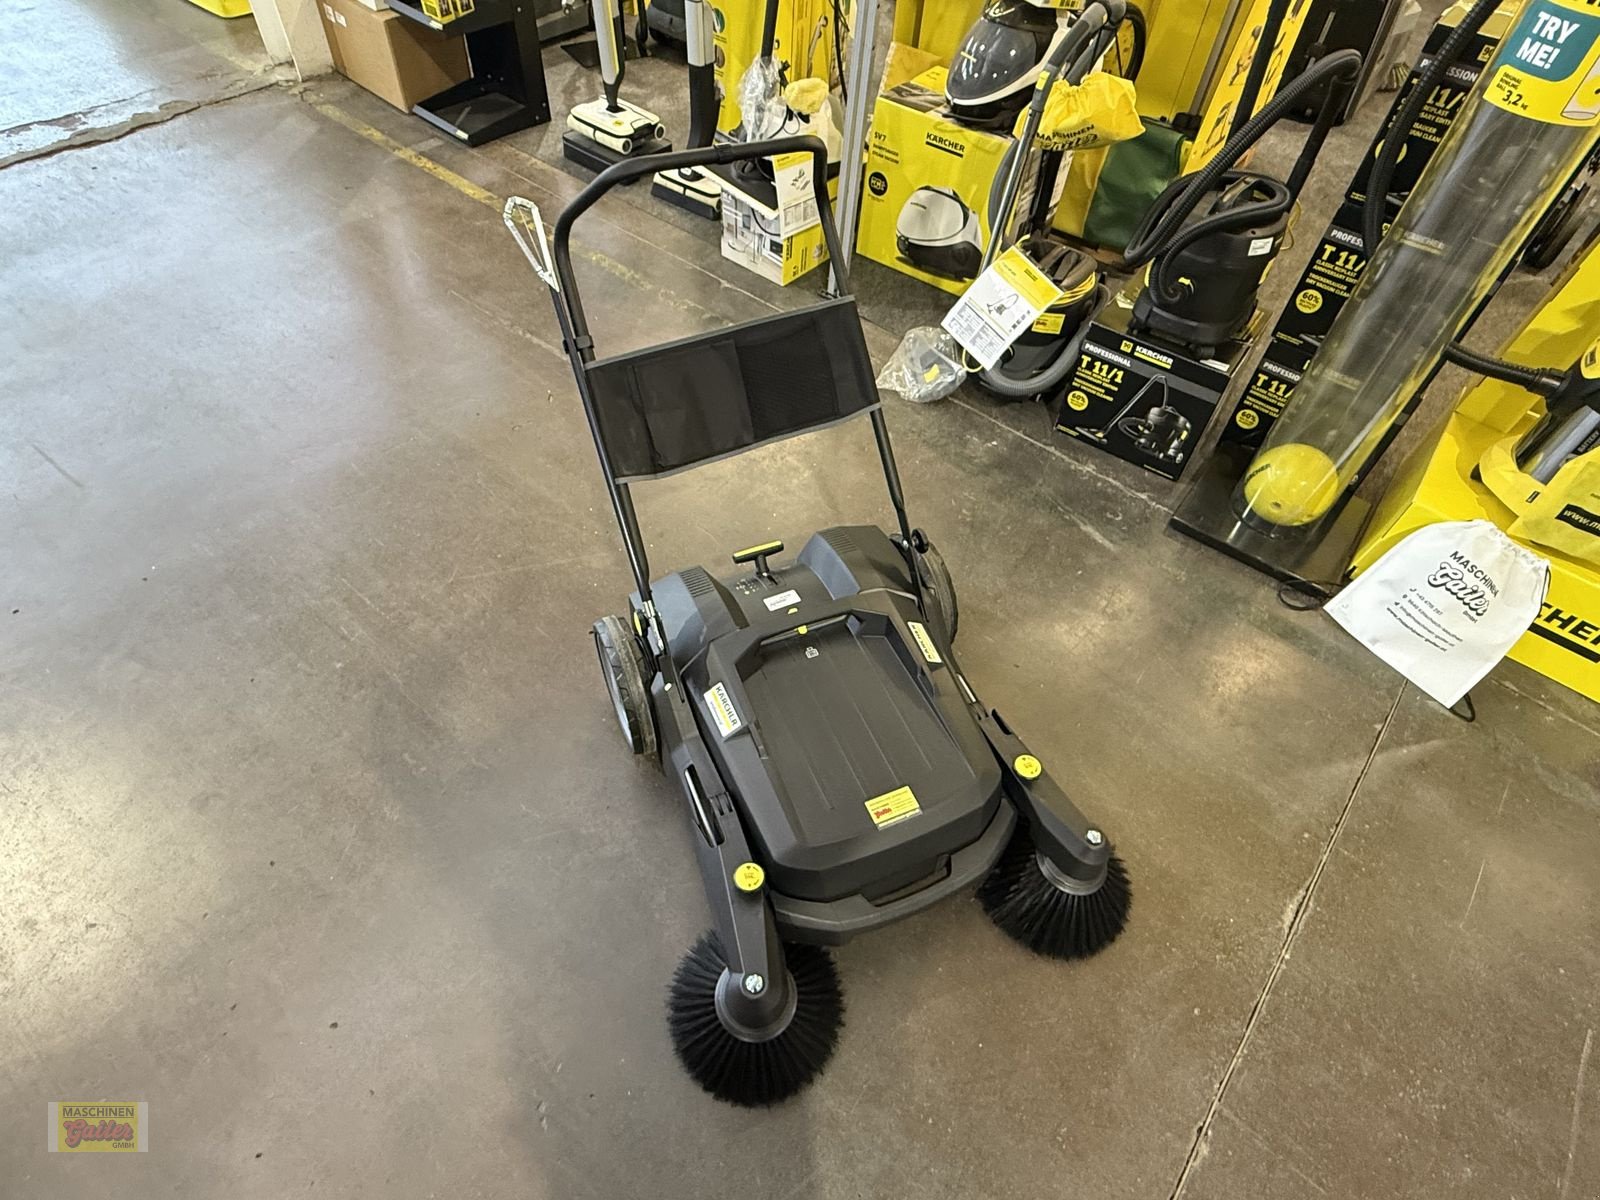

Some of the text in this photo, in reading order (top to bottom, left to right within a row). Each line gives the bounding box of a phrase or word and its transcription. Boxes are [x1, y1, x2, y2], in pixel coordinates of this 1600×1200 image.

[1532, 11, 1580, 44] TRY
[1515, 37, 1561, 70] ME!
[1502, 90, 1523, 106] 3,2
[874, 131, 887, 142] SV7
[1322, 244, 1336, 260] T
[1084, 343, 1131, 367] PROFESSIONAL
[1081, 354, 1124, 384] T 11/1
[1262, 362, 1302, 381] PROFESSIO
[1257, 373, 1268, 387] T
